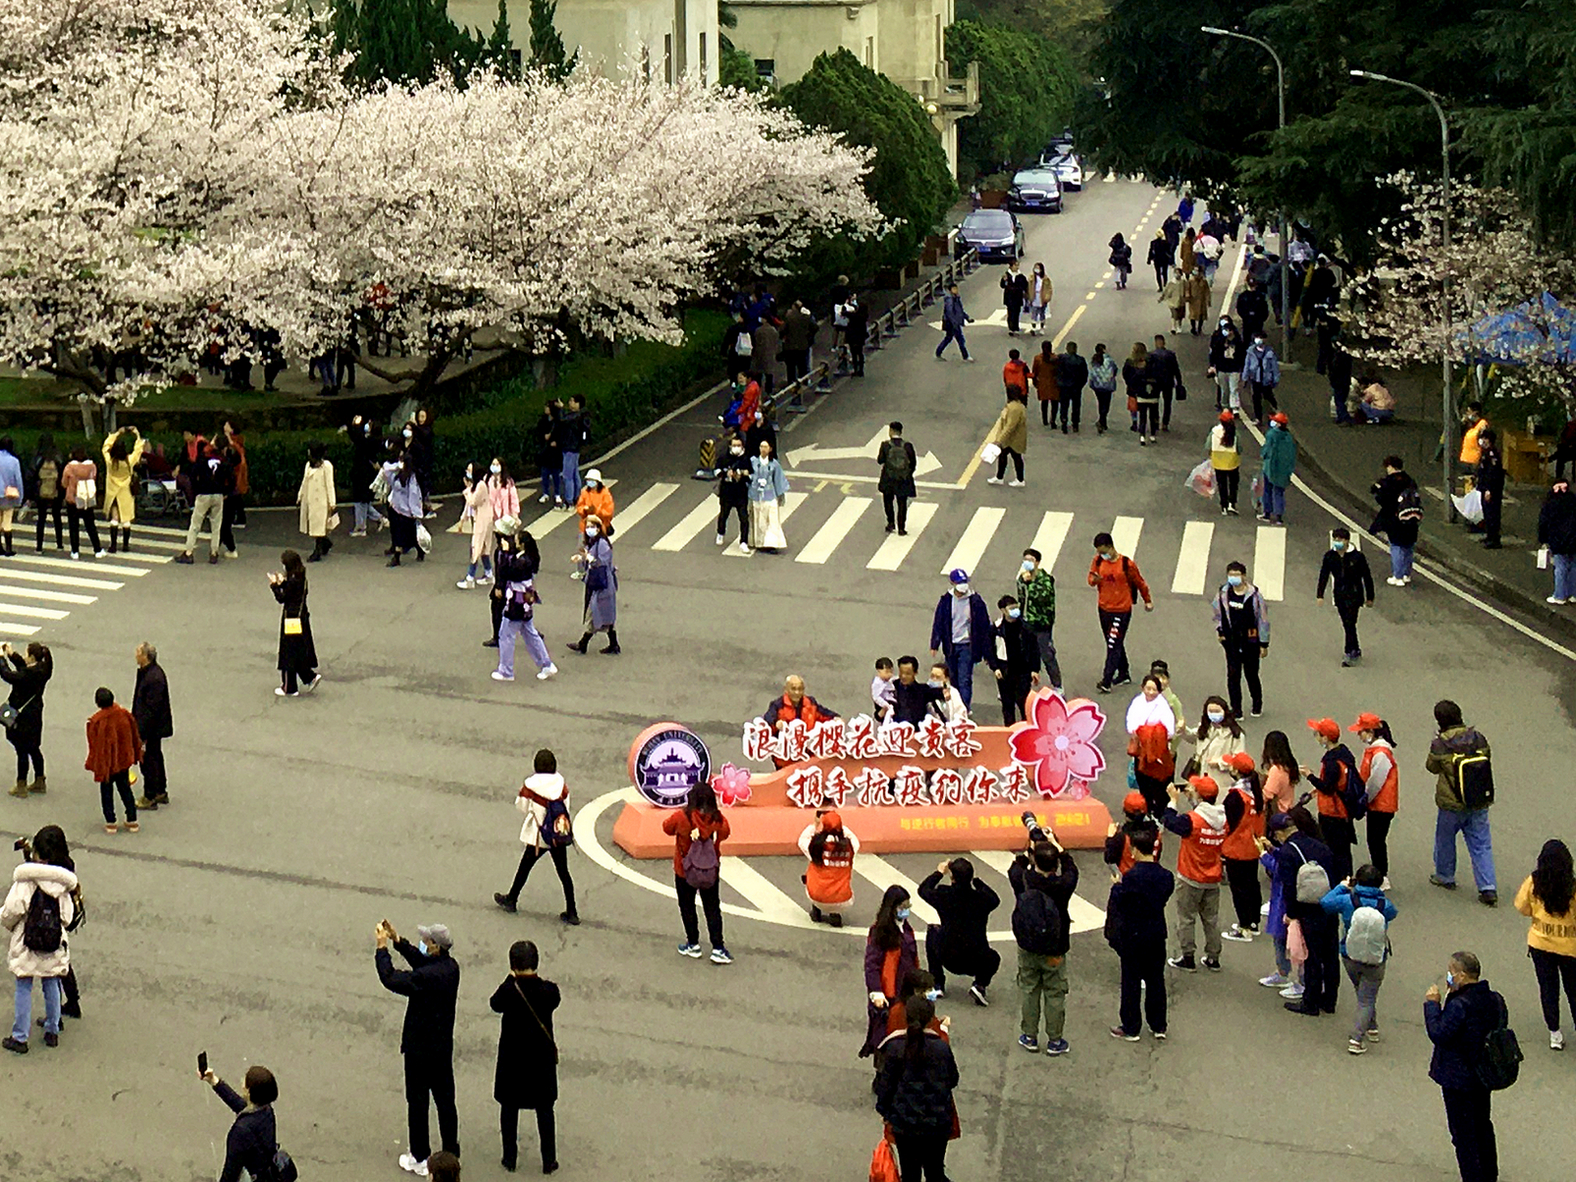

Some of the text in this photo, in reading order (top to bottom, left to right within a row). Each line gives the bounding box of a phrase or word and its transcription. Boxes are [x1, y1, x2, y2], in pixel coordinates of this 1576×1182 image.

[744, 714, 981, 760] 浪漫樱花迎贵客
[787, 763, 1029, 806] 携手抗疫约你来
